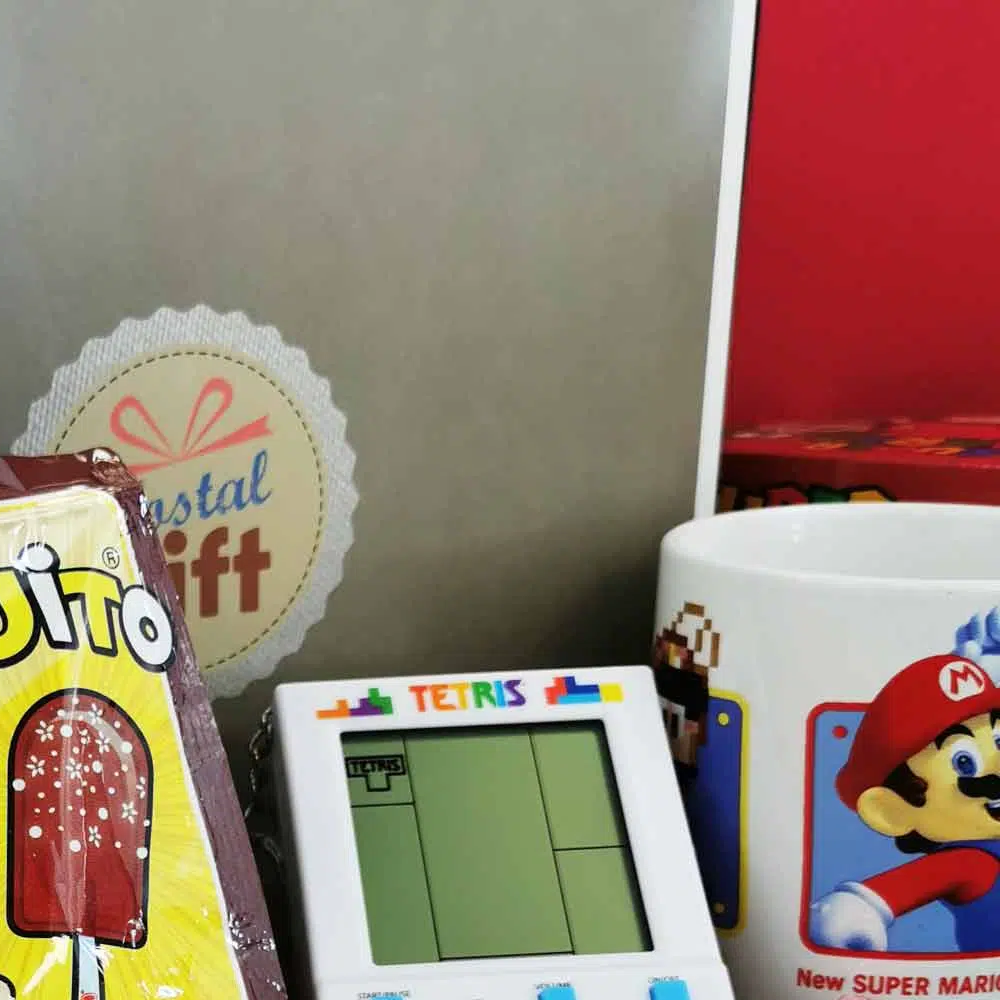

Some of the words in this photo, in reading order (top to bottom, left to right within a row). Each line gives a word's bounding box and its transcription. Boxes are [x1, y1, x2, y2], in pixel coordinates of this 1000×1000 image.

[163, 526, 272, 618] ift
[408, 679, 526, 713] TETRIS
[350, 758, 402, 773] TETRIS
[796, 967, 844, 992] New
[852, 973, 930, 996] SUPER
